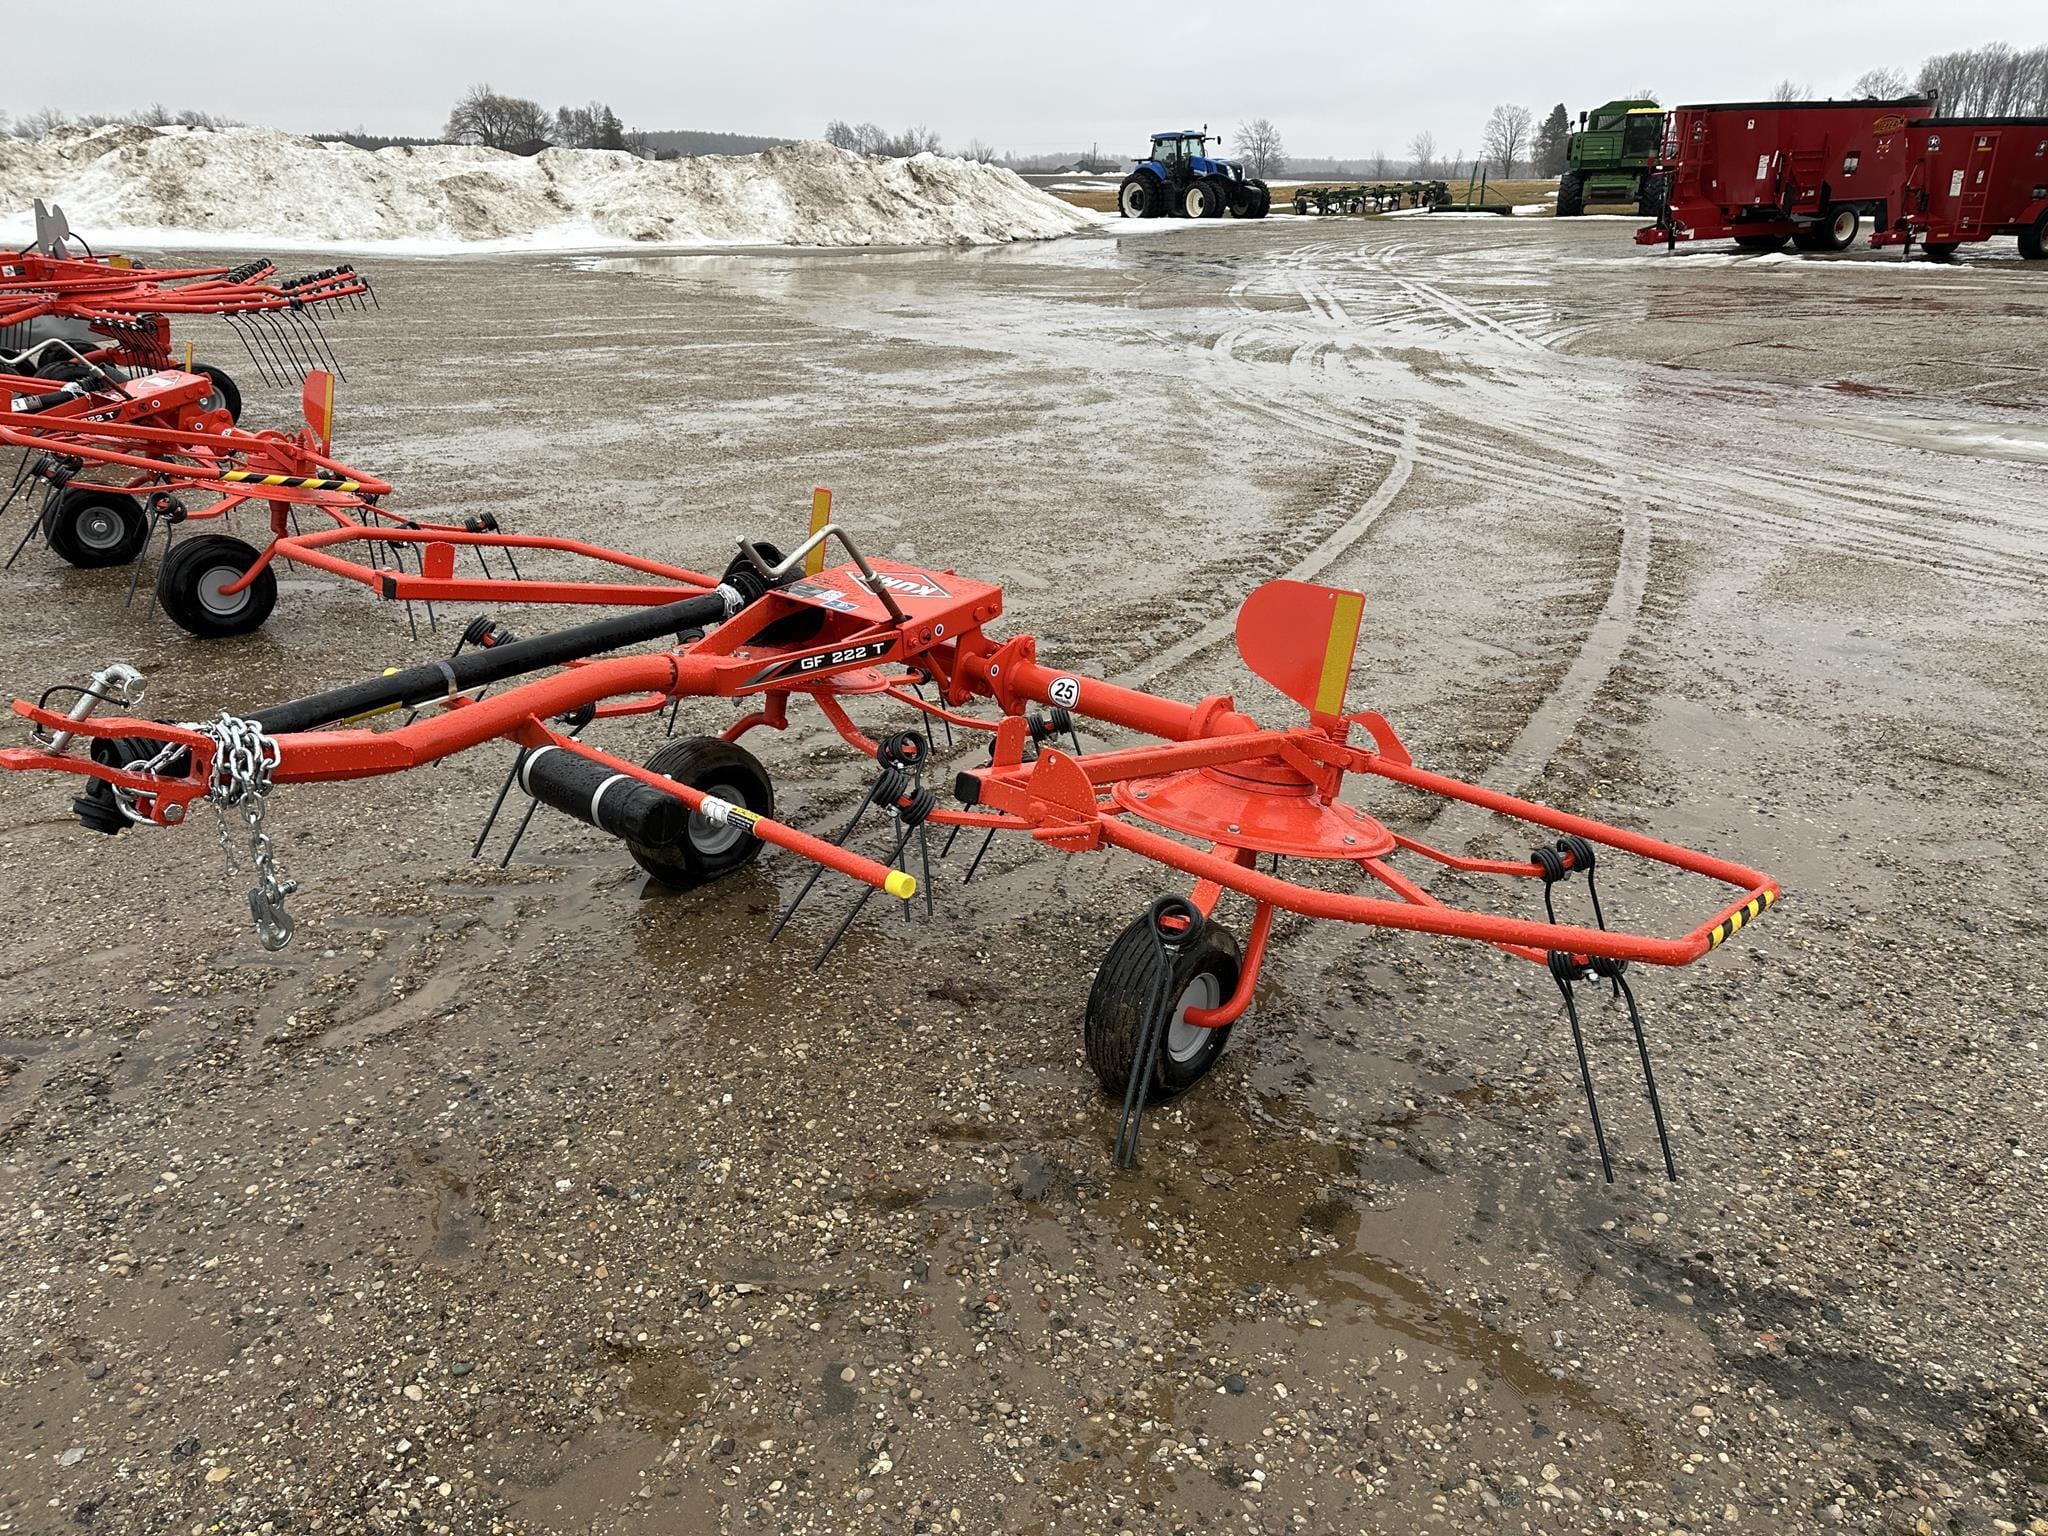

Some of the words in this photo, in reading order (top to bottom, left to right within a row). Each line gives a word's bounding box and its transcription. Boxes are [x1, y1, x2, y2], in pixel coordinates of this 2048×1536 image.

[857, 574, 938, 596] KUH
[800, 655, 825, 670] GF
[832, 647, 867, 664] 222
[872, 643, 885, 654] T
[1055, 682, 1075, 700] 25
